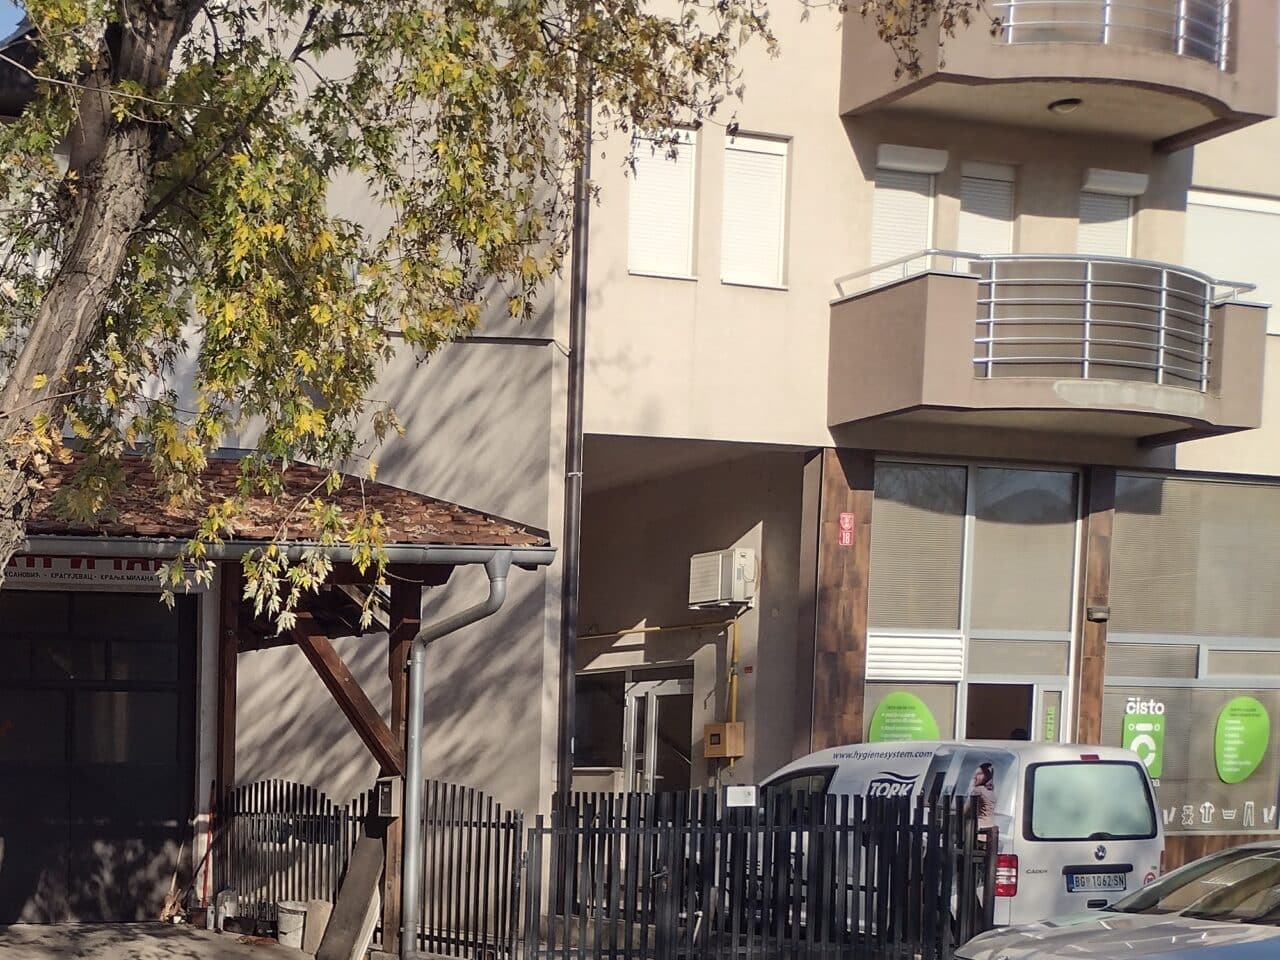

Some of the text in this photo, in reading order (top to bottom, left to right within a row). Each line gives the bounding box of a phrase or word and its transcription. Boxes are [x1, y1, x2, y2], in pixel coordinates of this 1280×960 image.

[842, 532, 851, 544] 18
[833, 750, 932, 760] www.hygienesystem.com
[869, 782, 914, 798] TORK
